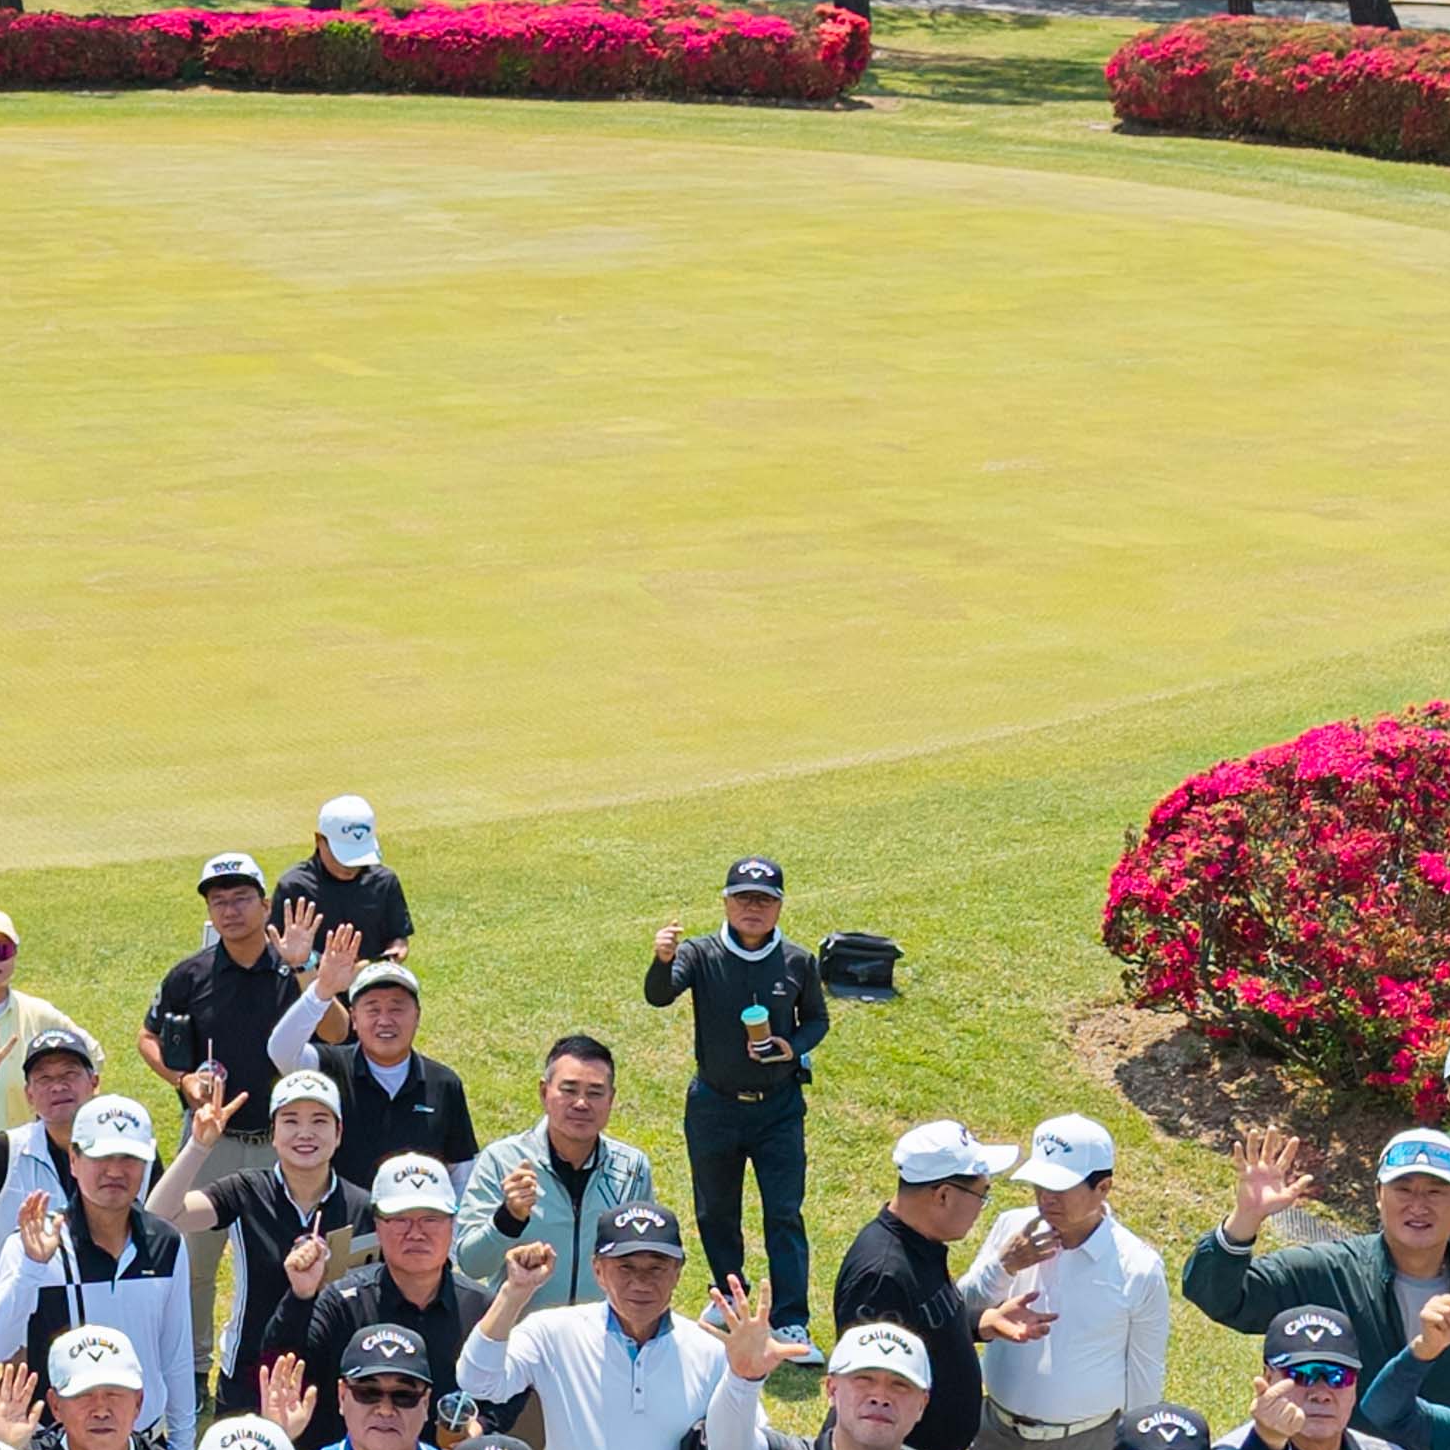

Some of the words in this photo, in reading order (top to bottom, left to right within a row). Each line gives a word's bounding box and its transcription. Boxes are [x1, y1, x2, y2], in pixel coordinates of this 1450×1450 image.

[615, 1206, 666, 1227] Callaway
[1285, 1315, 1343, 1337] Callaway
[70, 1338, 118, 1358] Callaway
[363, 1331, 415, 1352] Callaway
[859, 1330, 913, 1356] Callaway
[1138, 1412, 1196, 1435] Callaway
